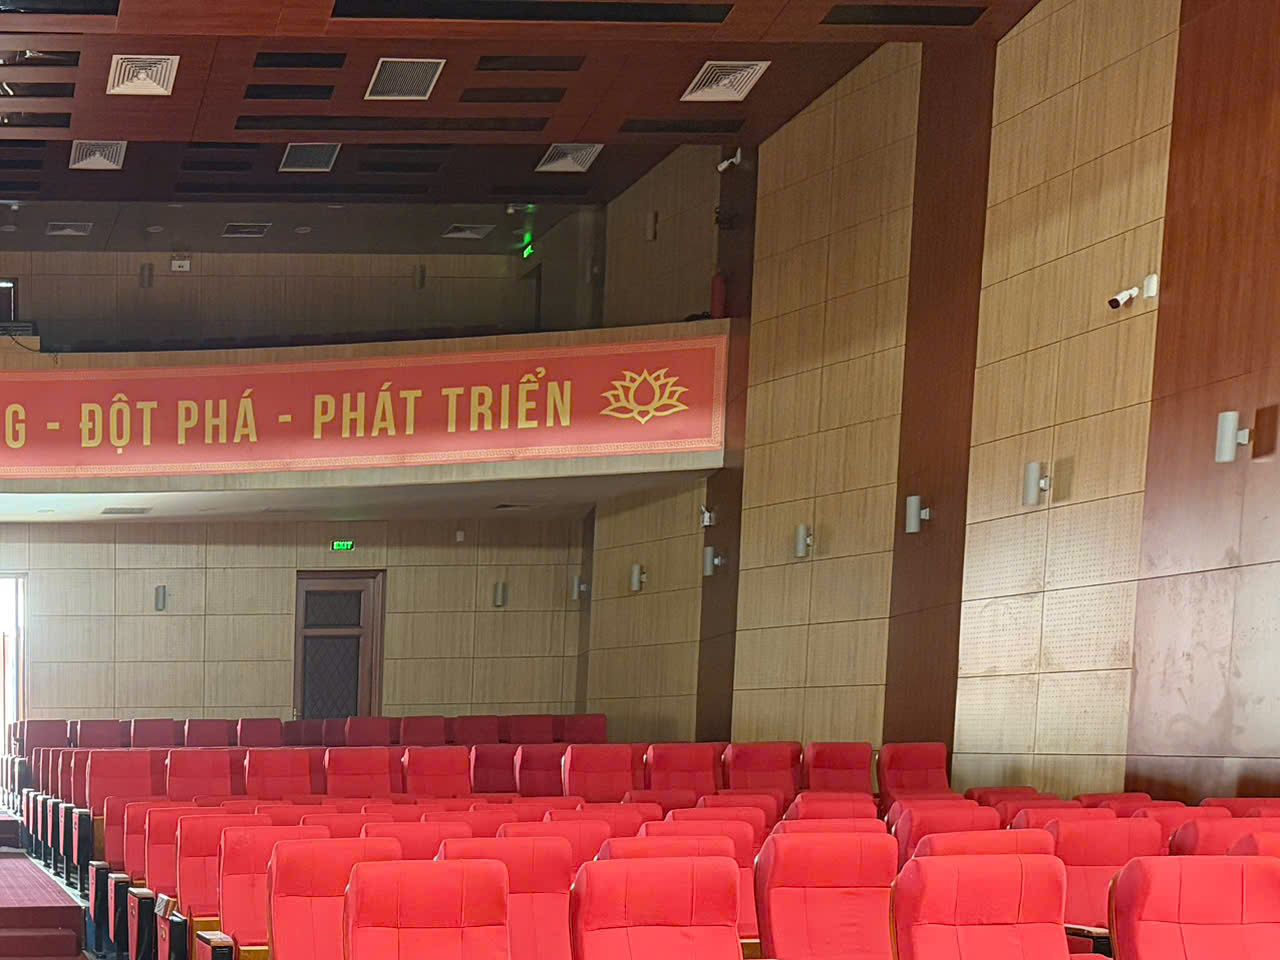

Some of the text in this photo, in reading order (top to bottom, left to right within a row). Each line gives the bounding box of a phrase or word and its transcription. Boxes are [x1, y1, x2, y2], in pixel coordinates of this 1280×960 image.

[46, 421, 60, 430] -
[80, 392, 157, 455] ĐỘT
[177, 388, 258, 445] PHÁ
[278, 414, 292, 423] -
[314, 381, 422, 441] PHÁT
[442, 366, 572, 433] TRIỂN
